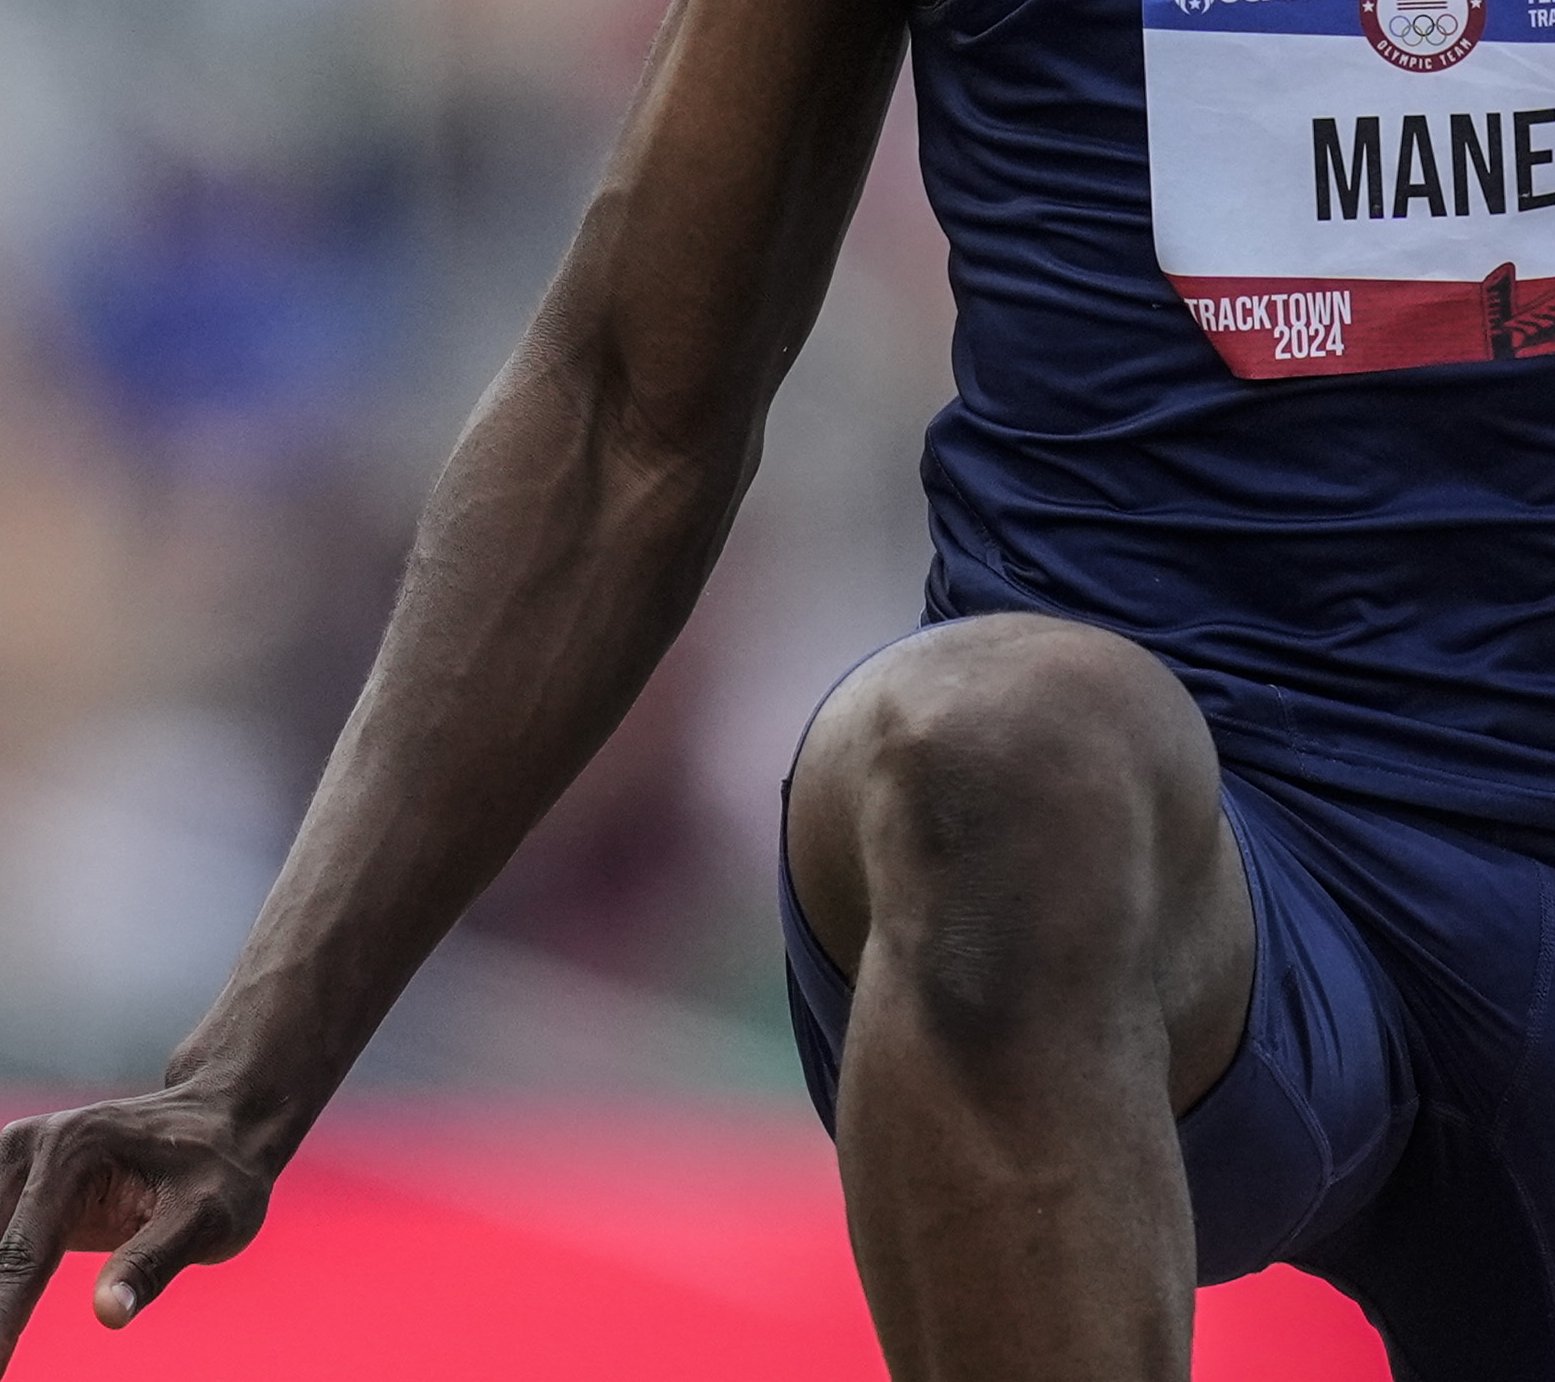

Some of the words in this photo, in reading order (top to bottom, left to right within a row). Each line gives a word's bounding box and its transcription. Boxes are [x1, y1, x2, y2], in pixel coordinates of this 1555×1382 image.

[1376, 39, 1433, 69] OLYMPIC
[1439, 38, 1473, 66] TEAM
[1273, 324, 1345, 360] 2024
